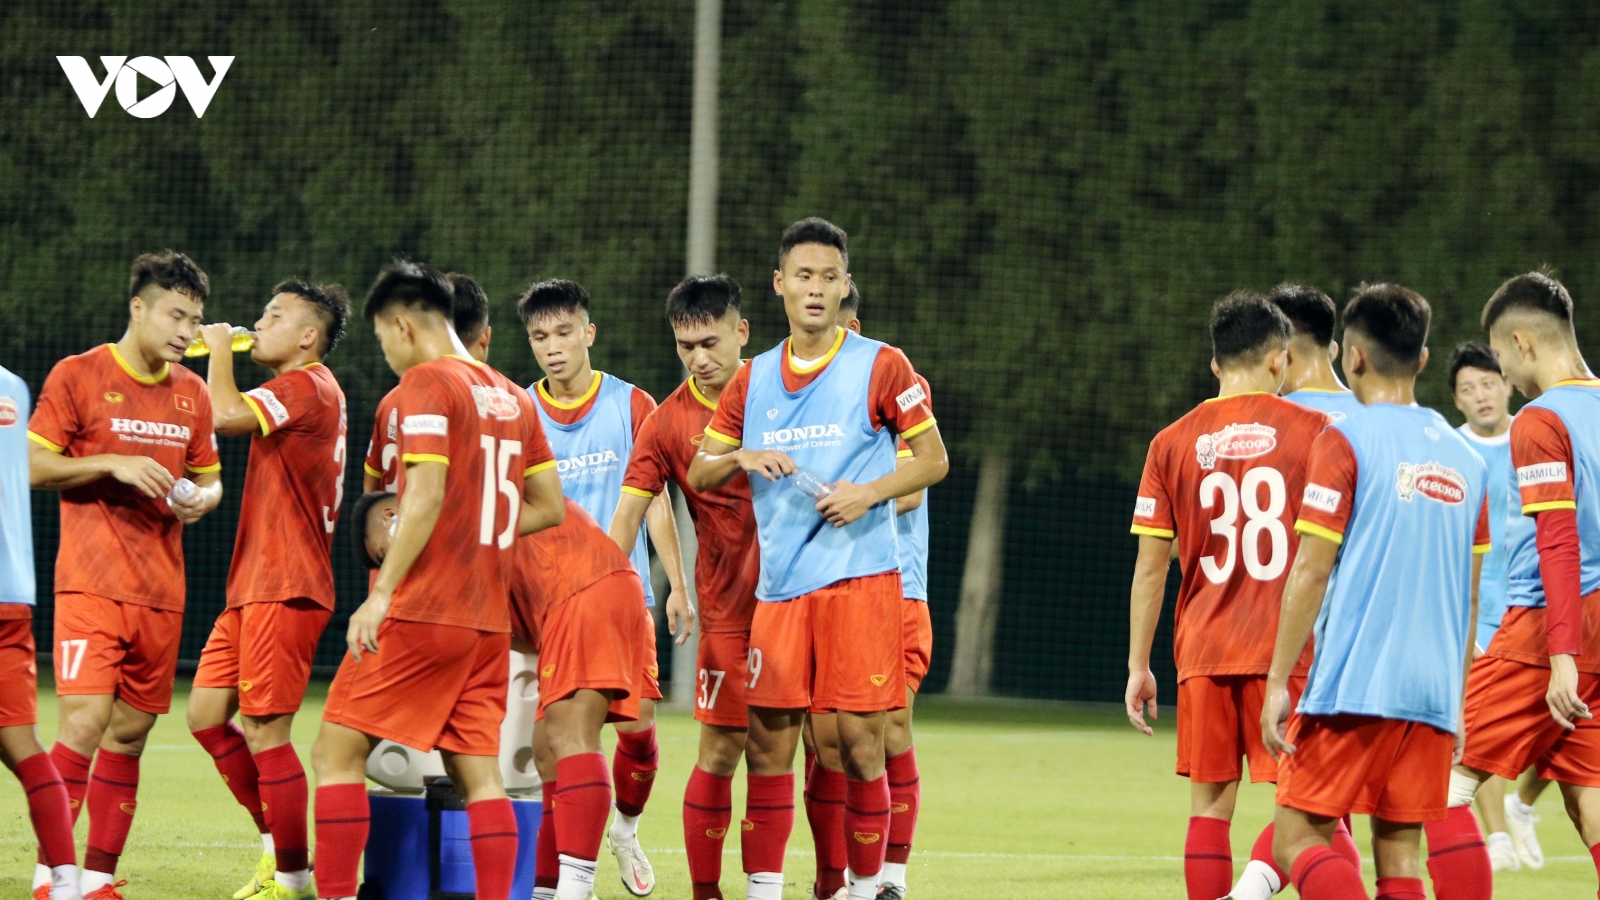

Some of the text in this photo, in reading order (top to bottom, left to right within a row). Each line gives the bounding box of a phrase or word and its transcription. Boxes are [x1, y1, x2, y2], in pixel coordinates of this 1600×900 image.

[110, 418, 191, 440] HONDA
[762, 424, 845, 445] HONDA
[776, 443, 801, 452] Power
[802, 441, 810, 449] of
[811, 440, 841, 448] Dreams
[556, 449, 619, 472] ONDA
[580, 468, 590, 476] of
[590, 464, 618, 474] Dreams
[480, 434, 522, 550] 15
[1200, 466, 1288, 585] 38
[60, 639, 88, 680] 17
[697, 668, 726, 710] 37
